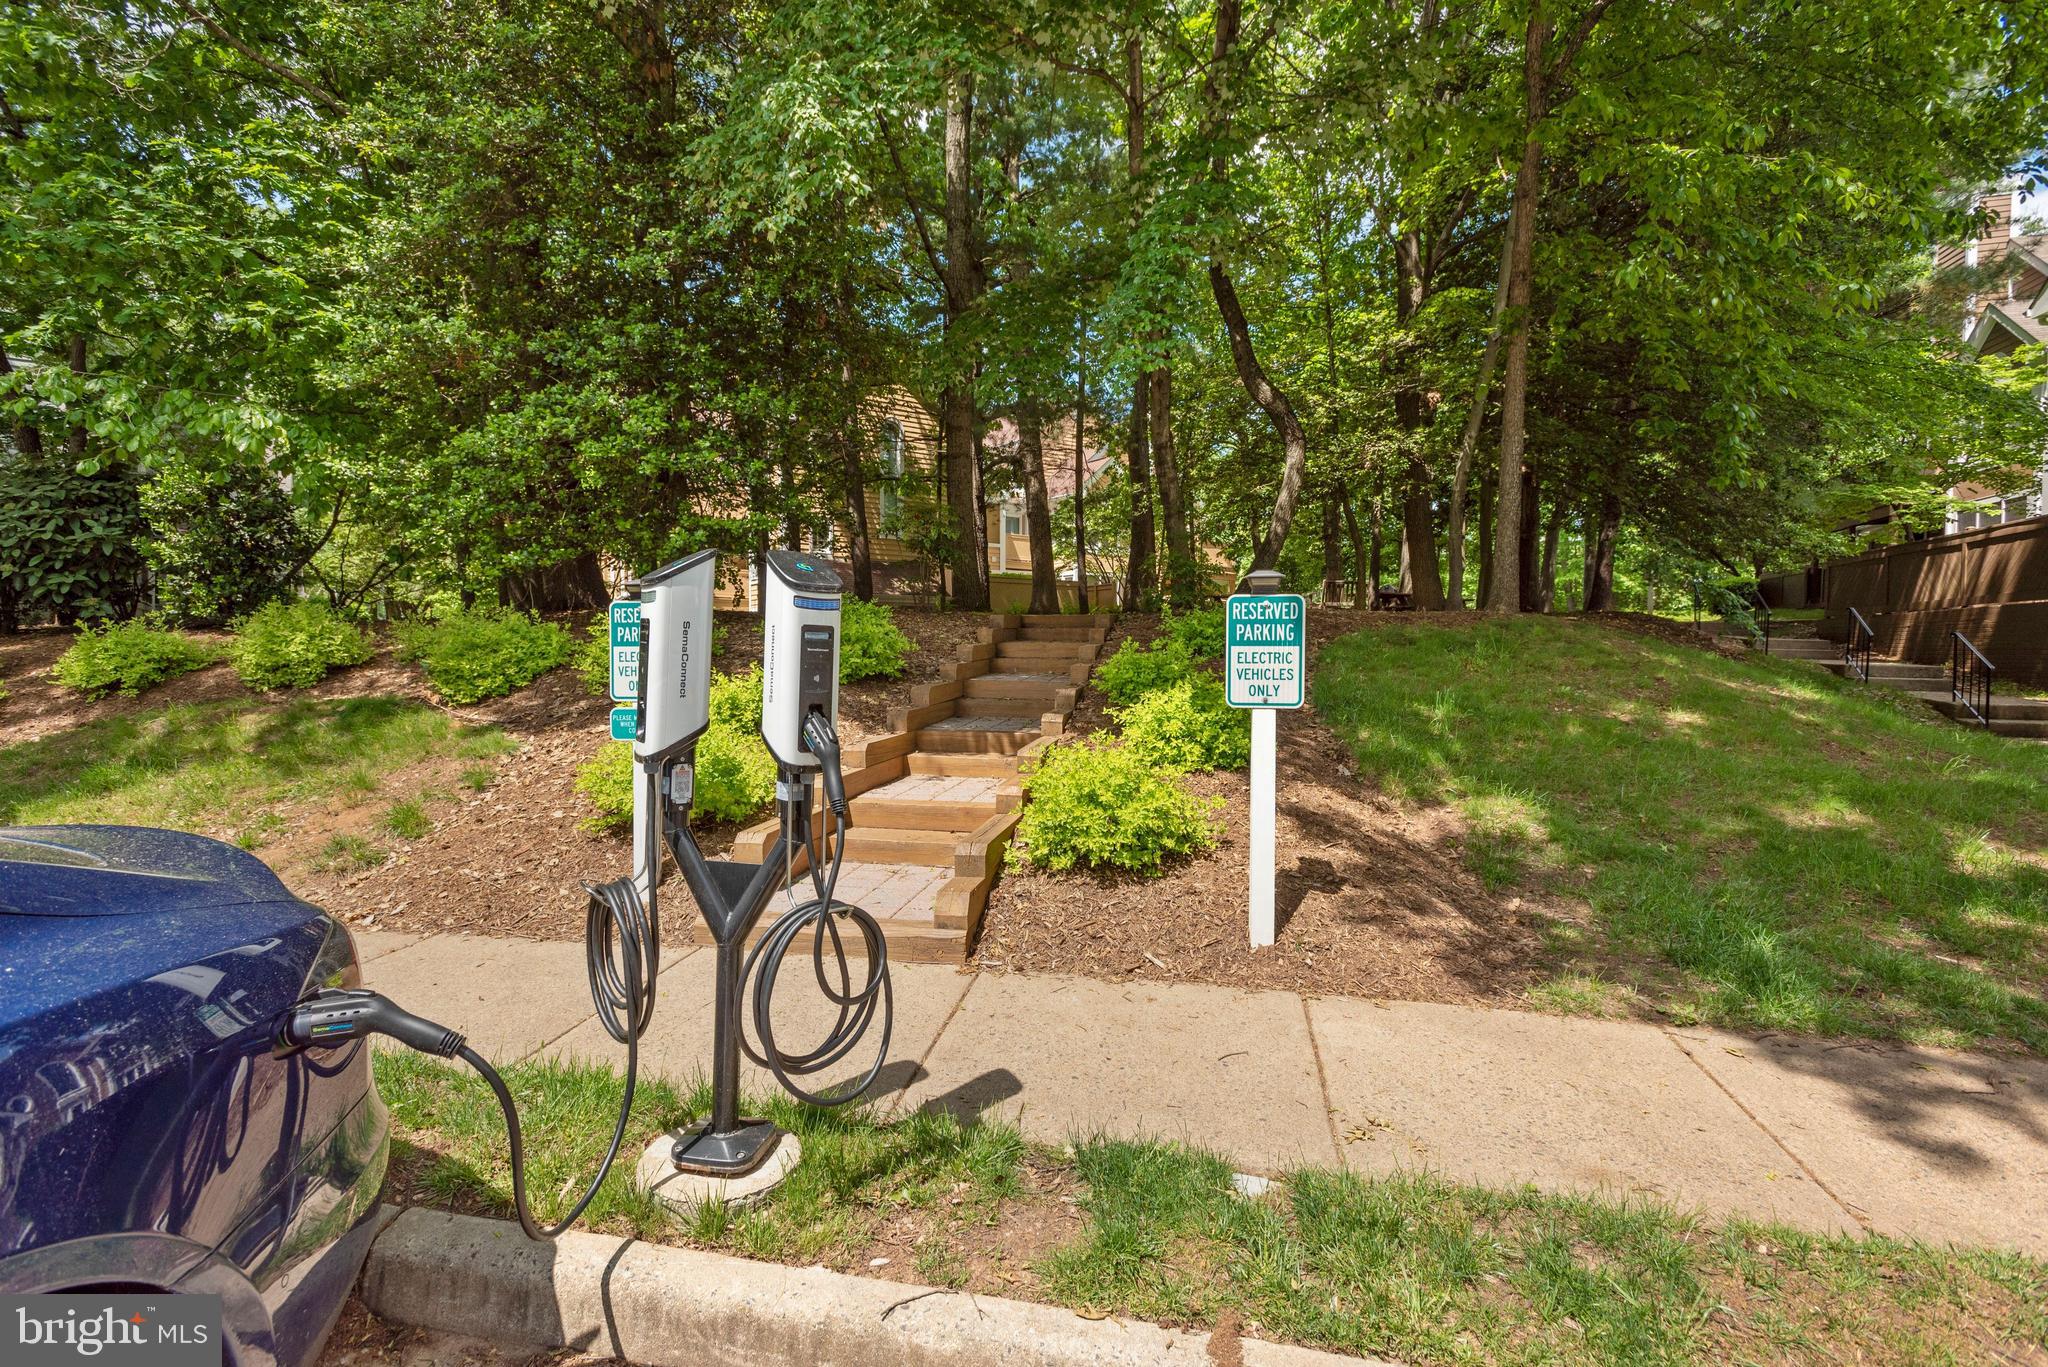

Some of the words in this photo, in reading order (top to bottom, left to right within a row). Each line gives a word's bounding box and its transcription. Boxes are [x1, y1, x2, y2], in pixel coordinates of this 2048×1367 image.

[614, 608, 640, 623] RESE
[1232, 602, 1299, 620] RESERVED
[1236, 623, 1295, 641] PARKING
[680, 620, 691, 699] SemaConnect
[1237, 652, 1293, 664] ELECTRIC
[1236, 668, 1294, 681] VEHICLES
[1248, 684, 1280, 697] ONLY
